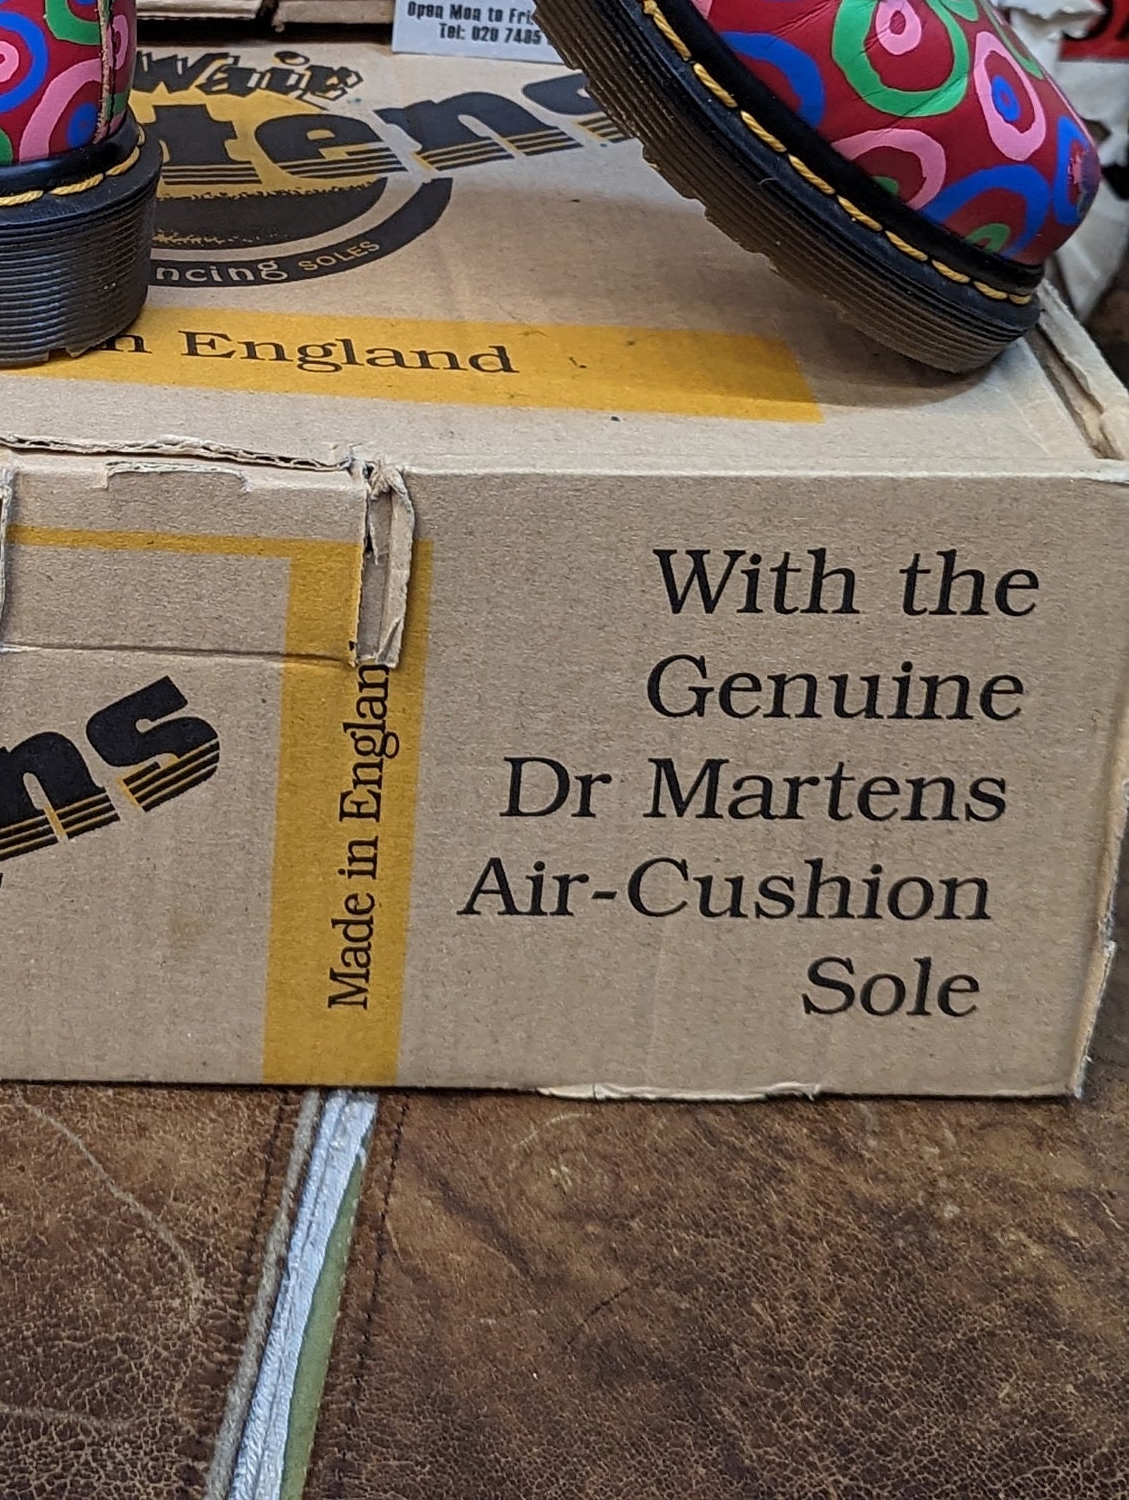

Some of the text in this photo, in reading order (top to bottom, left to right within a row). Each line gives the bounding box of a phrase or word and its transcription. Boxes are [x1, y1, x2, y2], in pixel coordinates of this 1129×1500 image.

[408, 1, 443, 19] Open
[450, 4, 481, 22] Mon
[488, 7, 503, 23] to
[439, 23, 465, 40] Tel:
[472, 26, 498, 42] 020
[133, 50, 364, 111] Wair
[156, 240, 380, 284] ncing SOLES
[178, 330, 520, 375] England
[653, 547, 1040, 617] With the
[647, 654, 1024, 721] Genuine
[500, 756, 1006, 822] Dr Martens
[327, 644, 401, 1010] Made in Englan
[456, 857, 991, 921] Air-Cushion
[801, 956, 980, 1018] Sole
